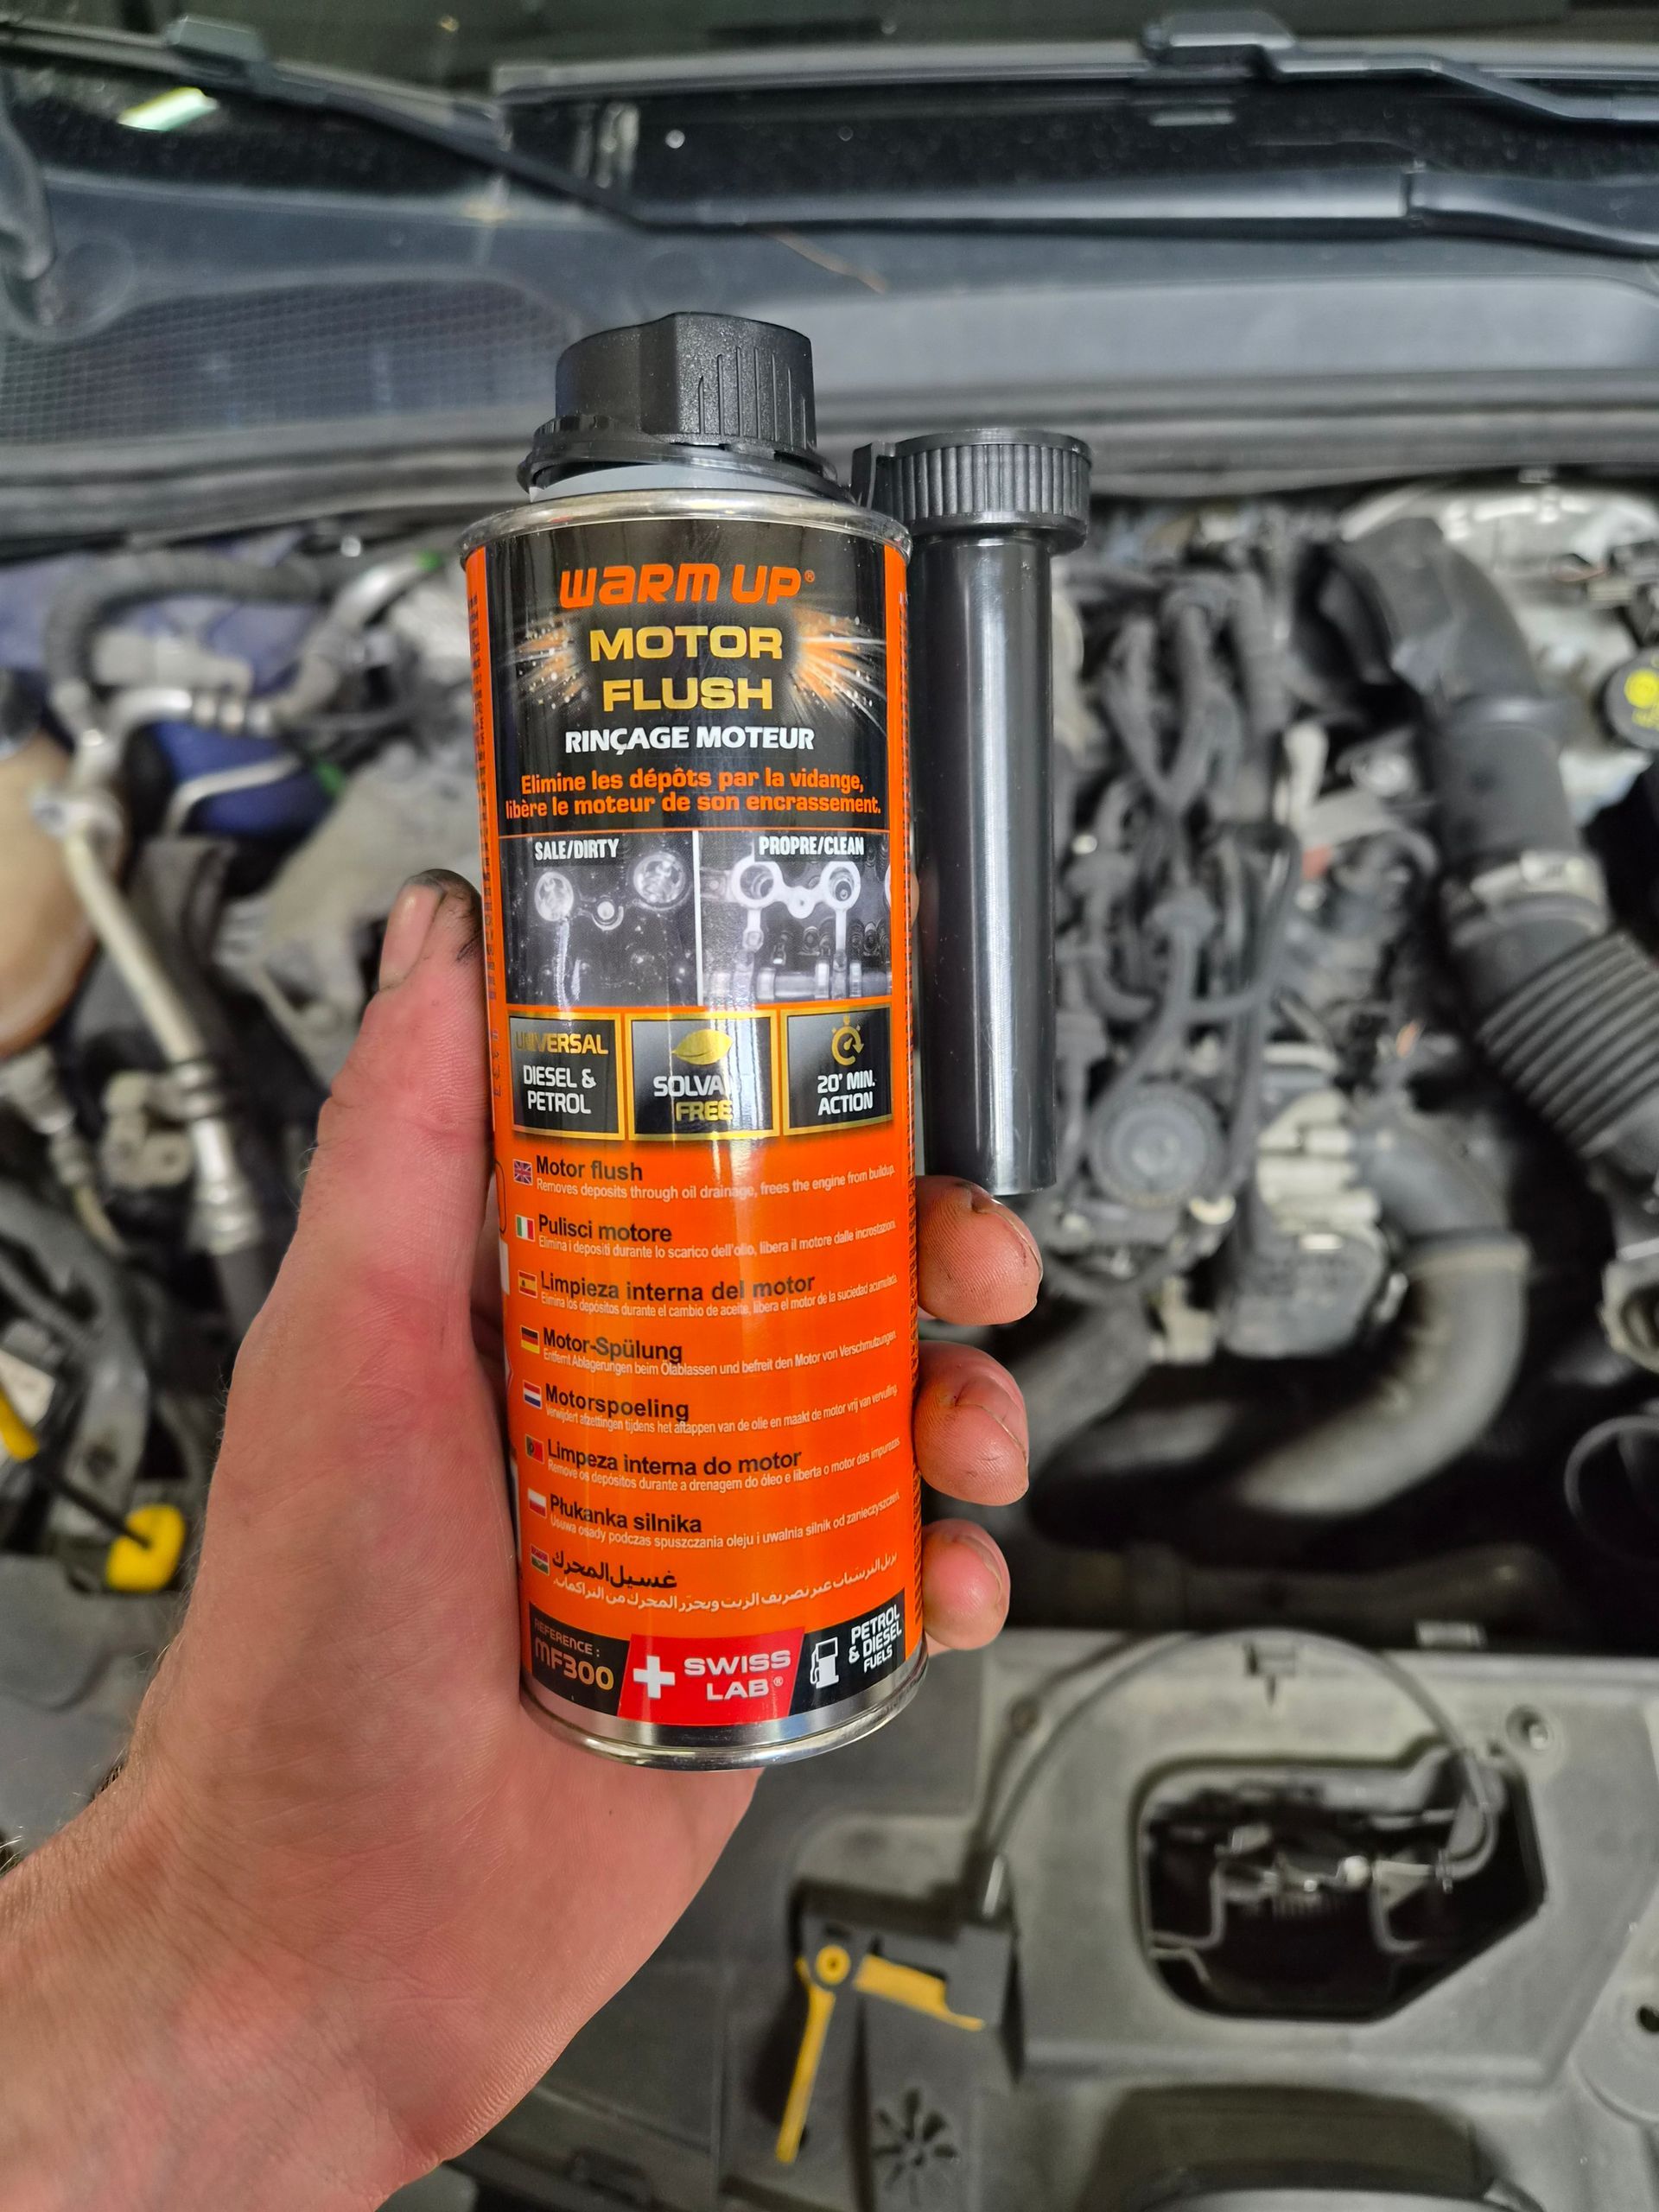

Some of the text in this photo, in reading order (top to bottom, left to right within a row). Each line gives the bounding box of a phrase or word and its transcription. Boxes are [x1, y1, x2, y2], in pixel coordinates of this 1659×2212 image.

[589, 626, 783, 662] MOTOR
[603, 677, 772, 712] FLUSH
[565, 726, 815, 755] RINÇAGE MOTEUR
[521, 767, 863, 794] Elimine les dépôts par la vidange,
[505, 791, 880, 819] libère le moteur de son encrassement.
[534, 838, 620, 861] SALE/DIRTY
[759, 836, 864, 855] PROPRE/CLEAN
[515, 1031, 609, 1055] UNIVERSAL
[523, 1065, 596, 1089] DIESEL &
[653, 1075, 752, 1097] SOLVA
[846, 1070, 876, 1090] MIN.
[527, 1090, 591, 1114] PETROL
[676, 1100, 734, 1122] FREE
[818, 1091, 874, 1116] ACTION
[536, 1154, 643, 1181] Motor flush
[537, 1178, 578, 1196] Removes
[581, 1183, 626, 1199] deposits
[631, 1185, 678, 1203] through
[682, 1185, 696, 1198] oil
[700, 1185, 757, 1200] drainage,
[760, 1182, 790, 1195] frees
[792, 1179, 810, 1192] the
[811, 1174, 846, 1192] engine
[847, 1171, 868, 1184] from
[538, 1213, 671, 1242] Pulisci motore
[538, 1236, 568, 1252] Elimina
[574, 1242, 611, 1257] depositi
[613, 1244, 652, 1258] durante
[655, 1245, 665, 1258] lo
[668, 1245, 709, 1259] scarico
[760, 1241, 789, 1255] libera
[791, 1238, 798, 1251] il
[799, 1235, 832, 1250] motore
[834, 1230, 854, 1244] dalle
[541, 1270, 816, 1301] Limpieza interna del motor
[566, 1297, 577, 1310] los
[621, 1303, 656, 1317] durante
[658, 1304, 666, 1317] el
[669, 1305, 704, 1317] cambio
[706, 1303, 719, 1316] de
[753, 1300, 779, 1314] libera
[780, 1299, 789, 1311] el
[791, 1295, 816, 1309] motor
[817, 1292, 828, 1305] de
[829, 1291, 836, 1303] la
[837, 1283, 868, 1301] suciedad
[543, 1326, 683, 1365] Motor-Spülung
[571, 1356, 632, 1376] Ablagerungen
[634, 1362, 659, 1376] beim
[661, 1359, 717, 1376] Ölablassen
[719, 1361, 741, 1375] und
[741, 1358, 773, 1374] befreit
[775, 1356, 793, 1370] den
[794, 1352, 821, 1367] Motor
[823, 1349, 838, 1362] von
[545, 1382, 690, 1422] Motorspoeling
[625, 1418, 655, 1434] tijdens
[658, 1421, 672, 1433] het
[674, 1421, 715, 1436] aftappen
[718, 1420, 735, 1433] van
[737, 1418, 750, 1432] de
[751, 1416, 768, 1430] olie
[770, 1417, 780, 1427] en
[784, 1411, 810, 1426] maakt
[811, 1408, 822, 1421] de
[823, 1403, 846, 1419] motor
[847, 1398, 858, 1414] vrij
[859, 1395, 871, 1408] van
[547, 1438, 802, 1476] Limpeza interna do motor
[548, 1459, 578, 1479] Remove
[579, 1470, 589, 1482] os
[591, 1471, 637, 1489] depósitos
[639, 1477, 678, 1491] durante
[680, 1481, 687, 1491] a
[689, 1476, 742, 1494] drenagem
[745, 1475, 759, 1488] do
[760, 1471, 783, 1487] óleo
[785, 1471, 791, 1483] e
[793, 1468, 822, 1483] liberta
[823, 1465, 830, 1475] o
[830, 1457, 855, 1473] motor
[856, 1452, 870, 1465] das
[550, 1493, 702, 1534] Płukanka silnika
[550, 1513, 576, 1534] Usuwa
[578, 1525, 606, 1542] osady
[608, 1531, 652, 1546] podczas
[654, 1535, 723, 1550] spuszczania
[726, 1534, 753, 1549] oleju
[763, 1527, 803, 1544] uwalnia
[805, 1518, 831, 1536] silnik
[833, 1514, 845, 1529] od
[534, 1618, 593, 1656] REFERENCE
[851, 1604, 900, 1645] PETROL
[848, 1620, 902, 1664] & DIESEL
[535, 1637, 614, 1691] MF300
[684, 1649, 791, 1675] SWISS
[863, 1644, 893, 1674] FUELS
